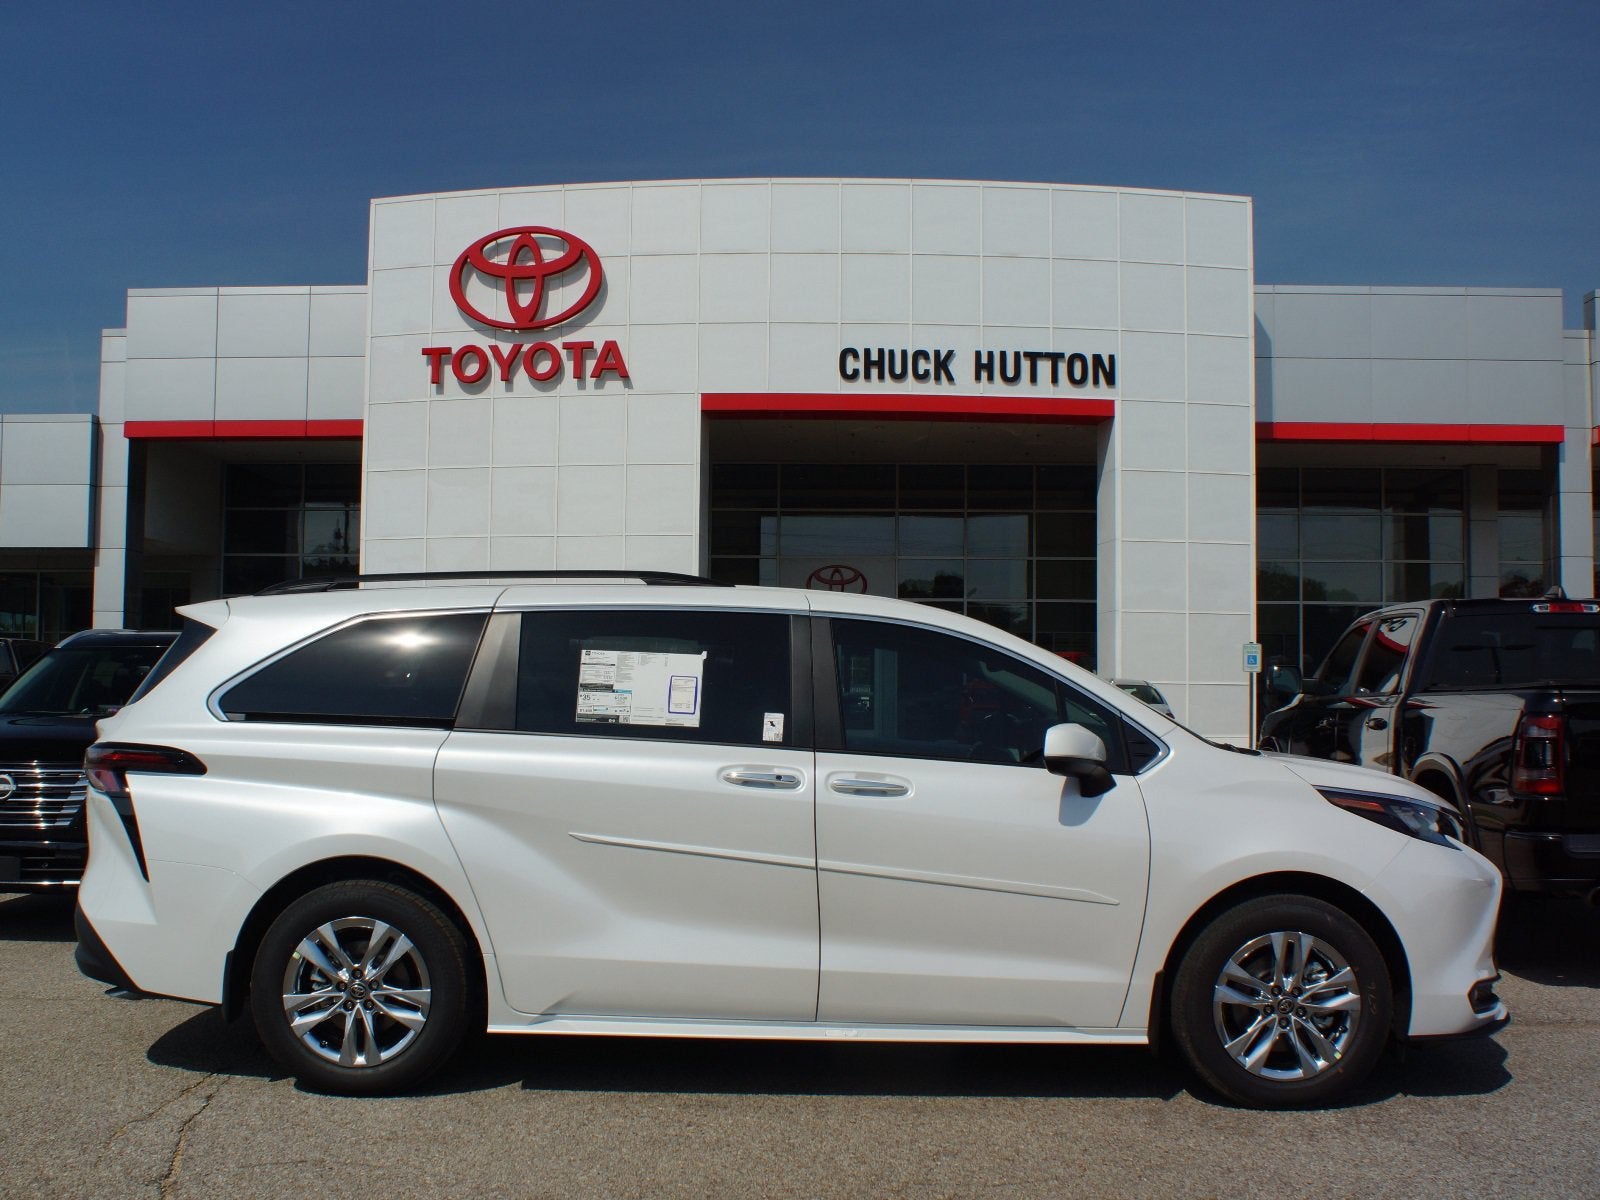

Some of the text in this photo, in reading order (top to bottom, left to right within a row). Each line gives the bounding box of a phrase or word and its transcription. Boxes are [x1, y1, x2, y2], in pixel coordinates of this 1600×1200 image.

[422, 340, 629, 384] TOYOTA
[839, 347, 1116, 386] CHUCK HUTTON
